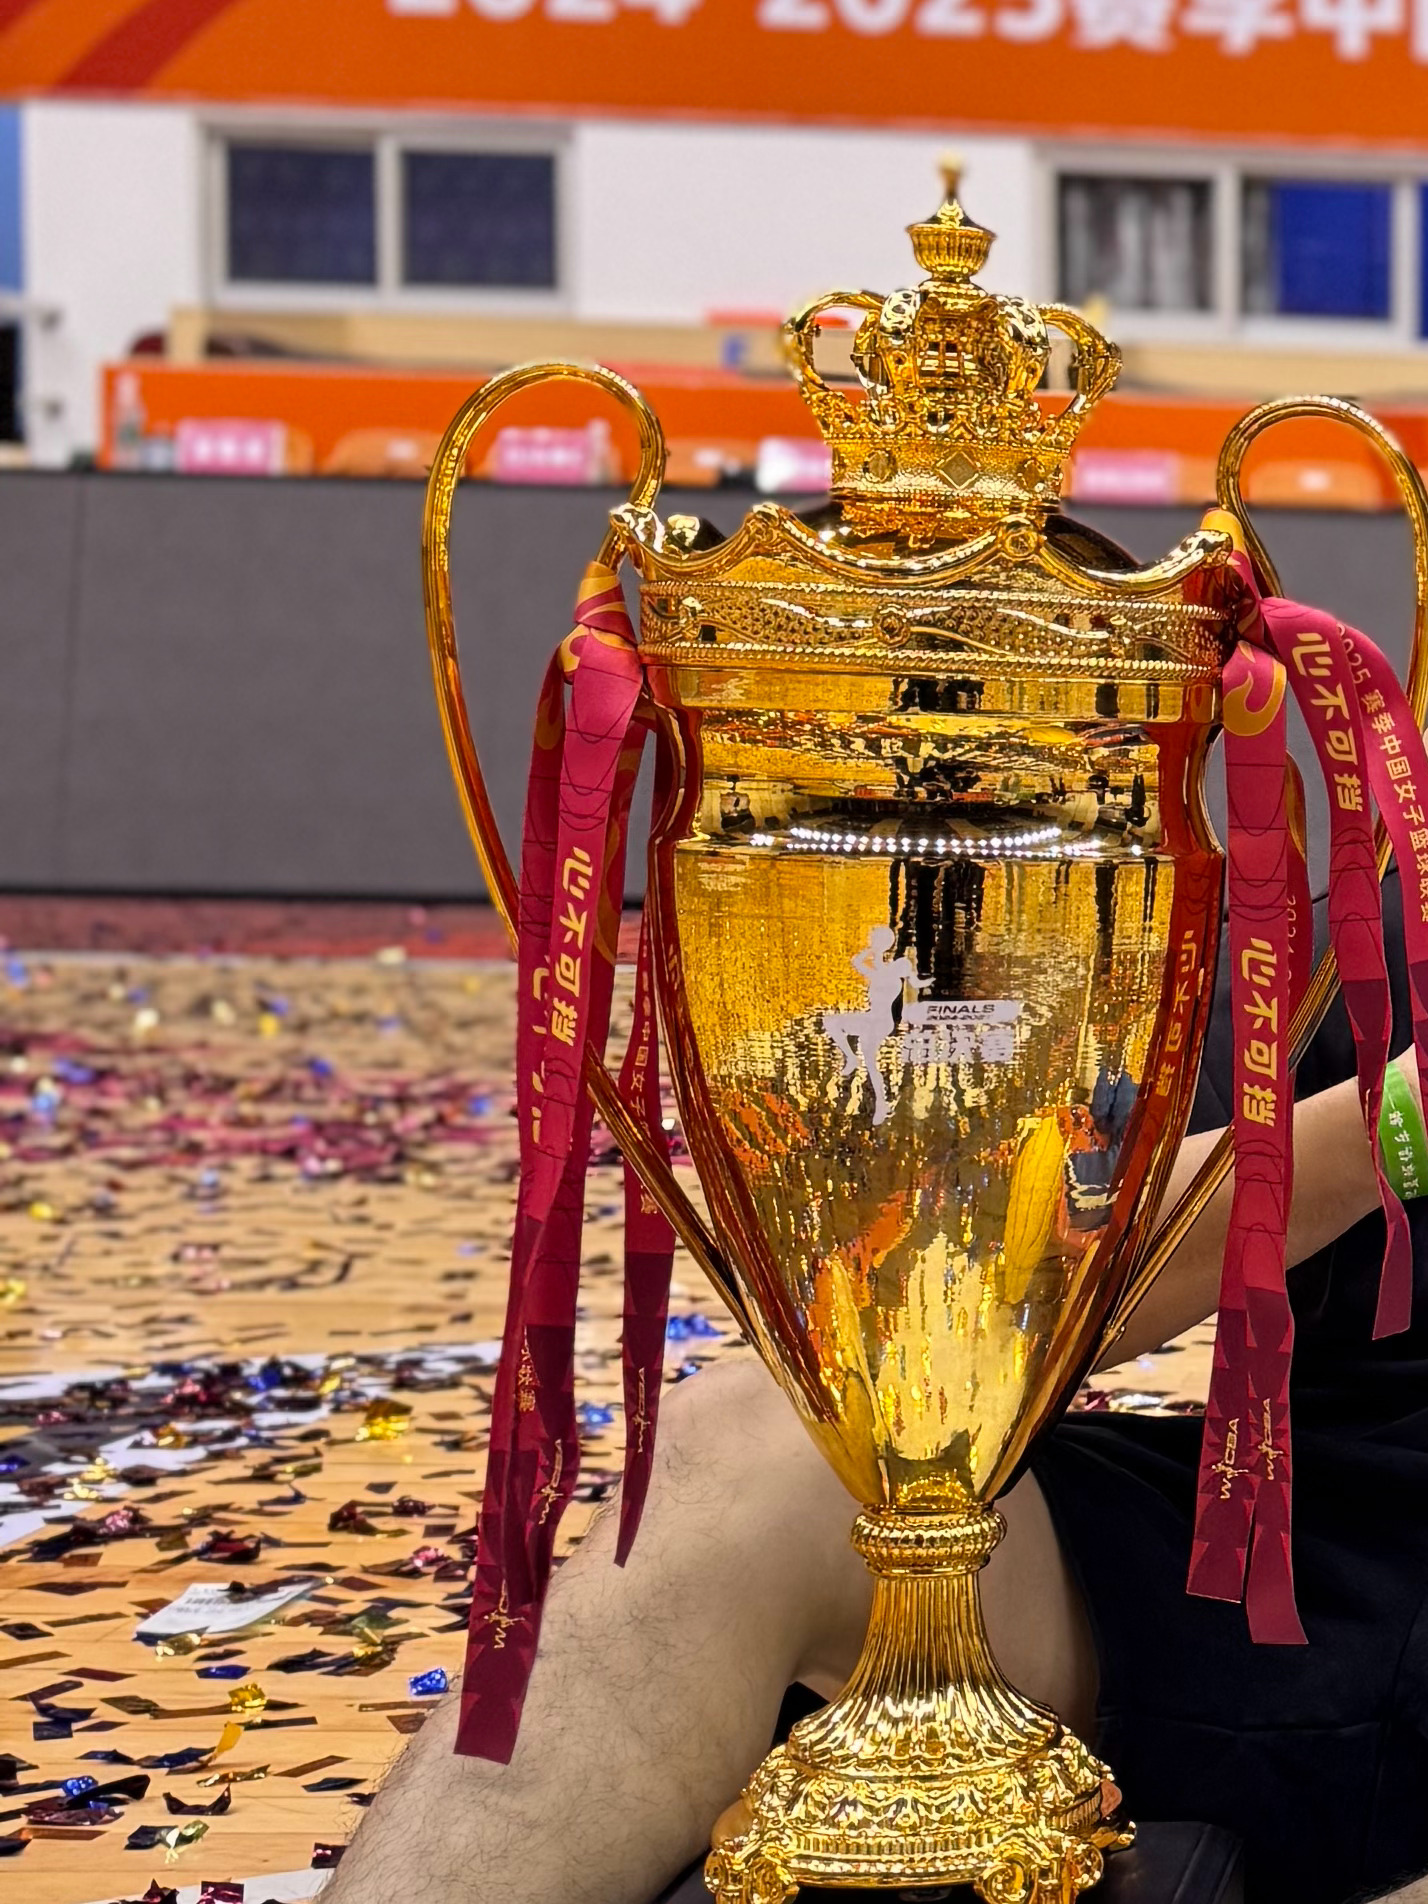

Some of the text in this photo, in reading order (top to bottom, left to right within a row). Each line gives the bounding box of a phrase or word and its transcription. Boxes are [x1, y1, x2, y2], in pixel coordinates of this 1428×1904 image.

[1295, 630, 1364, 814] 心不可挡
[551, 846, 594, 1047] 心不可挡
[926, 1003, 996, 1015] FINALS
[1240, 936, 1279, 1128] 心不可挡
